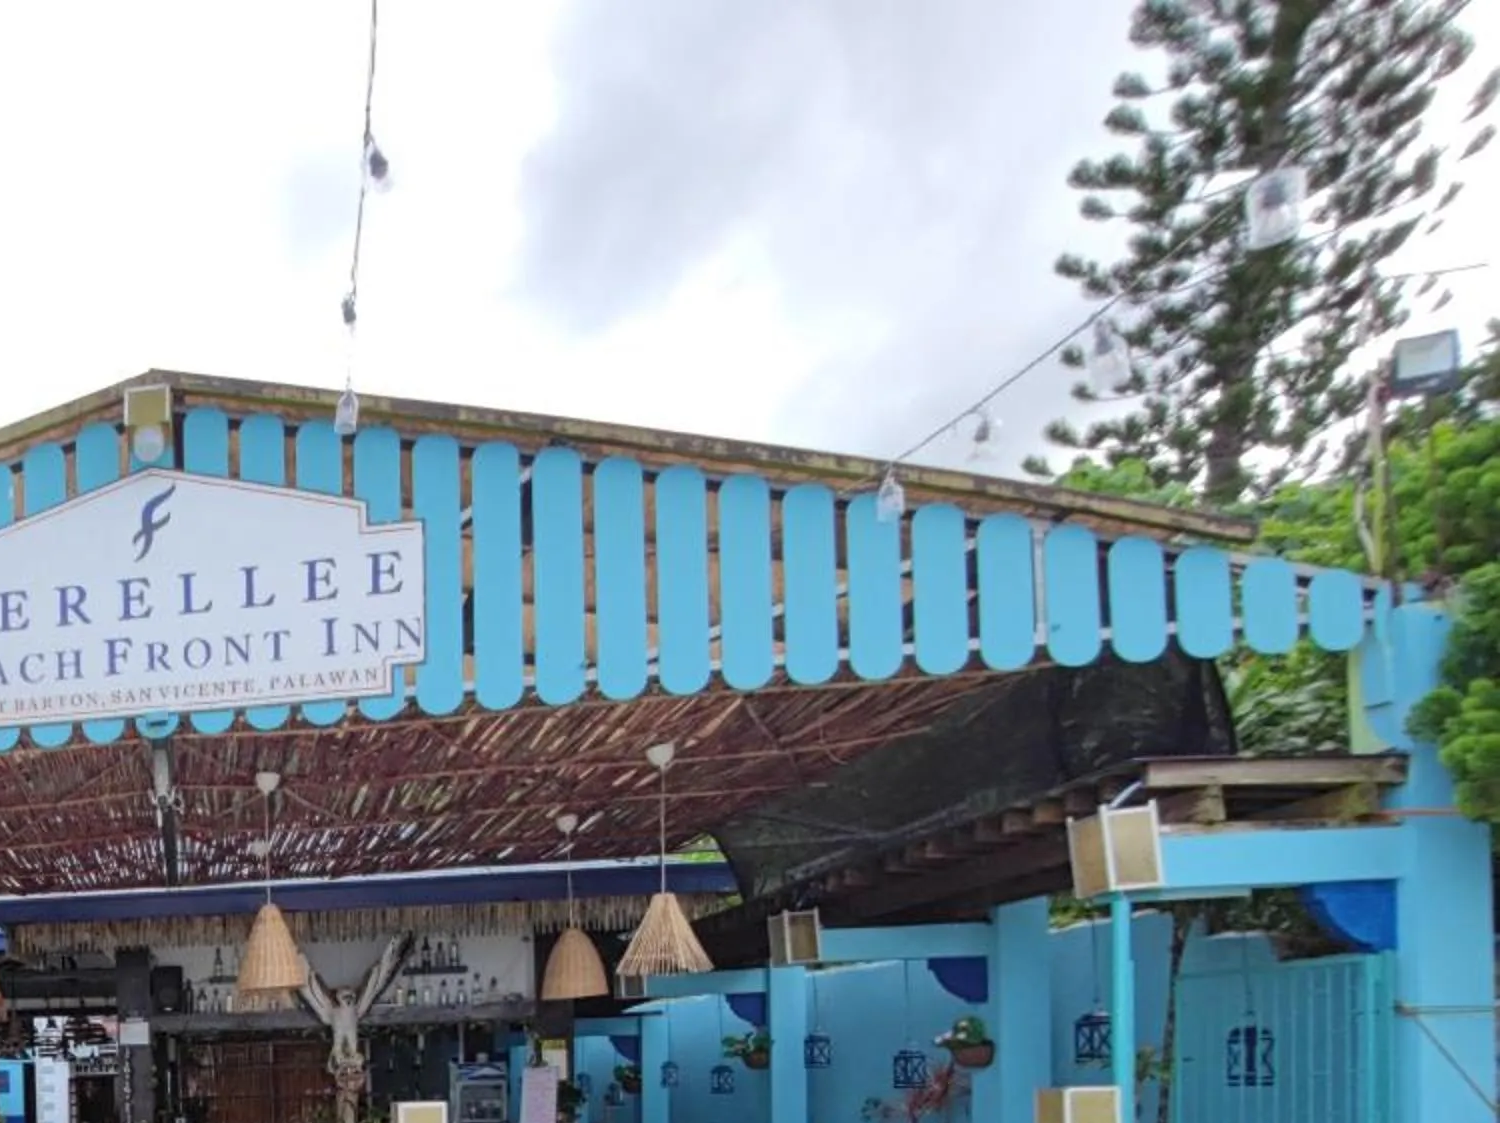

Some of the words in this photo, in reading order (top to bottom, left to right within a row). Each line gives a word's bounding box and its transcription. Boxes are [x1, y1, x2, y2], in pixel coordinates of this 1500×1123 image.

[322, 617, 421, 657] INN
[111, 686, 152, 705] SAN
[269, 667, 380, 691] PALAWAN
